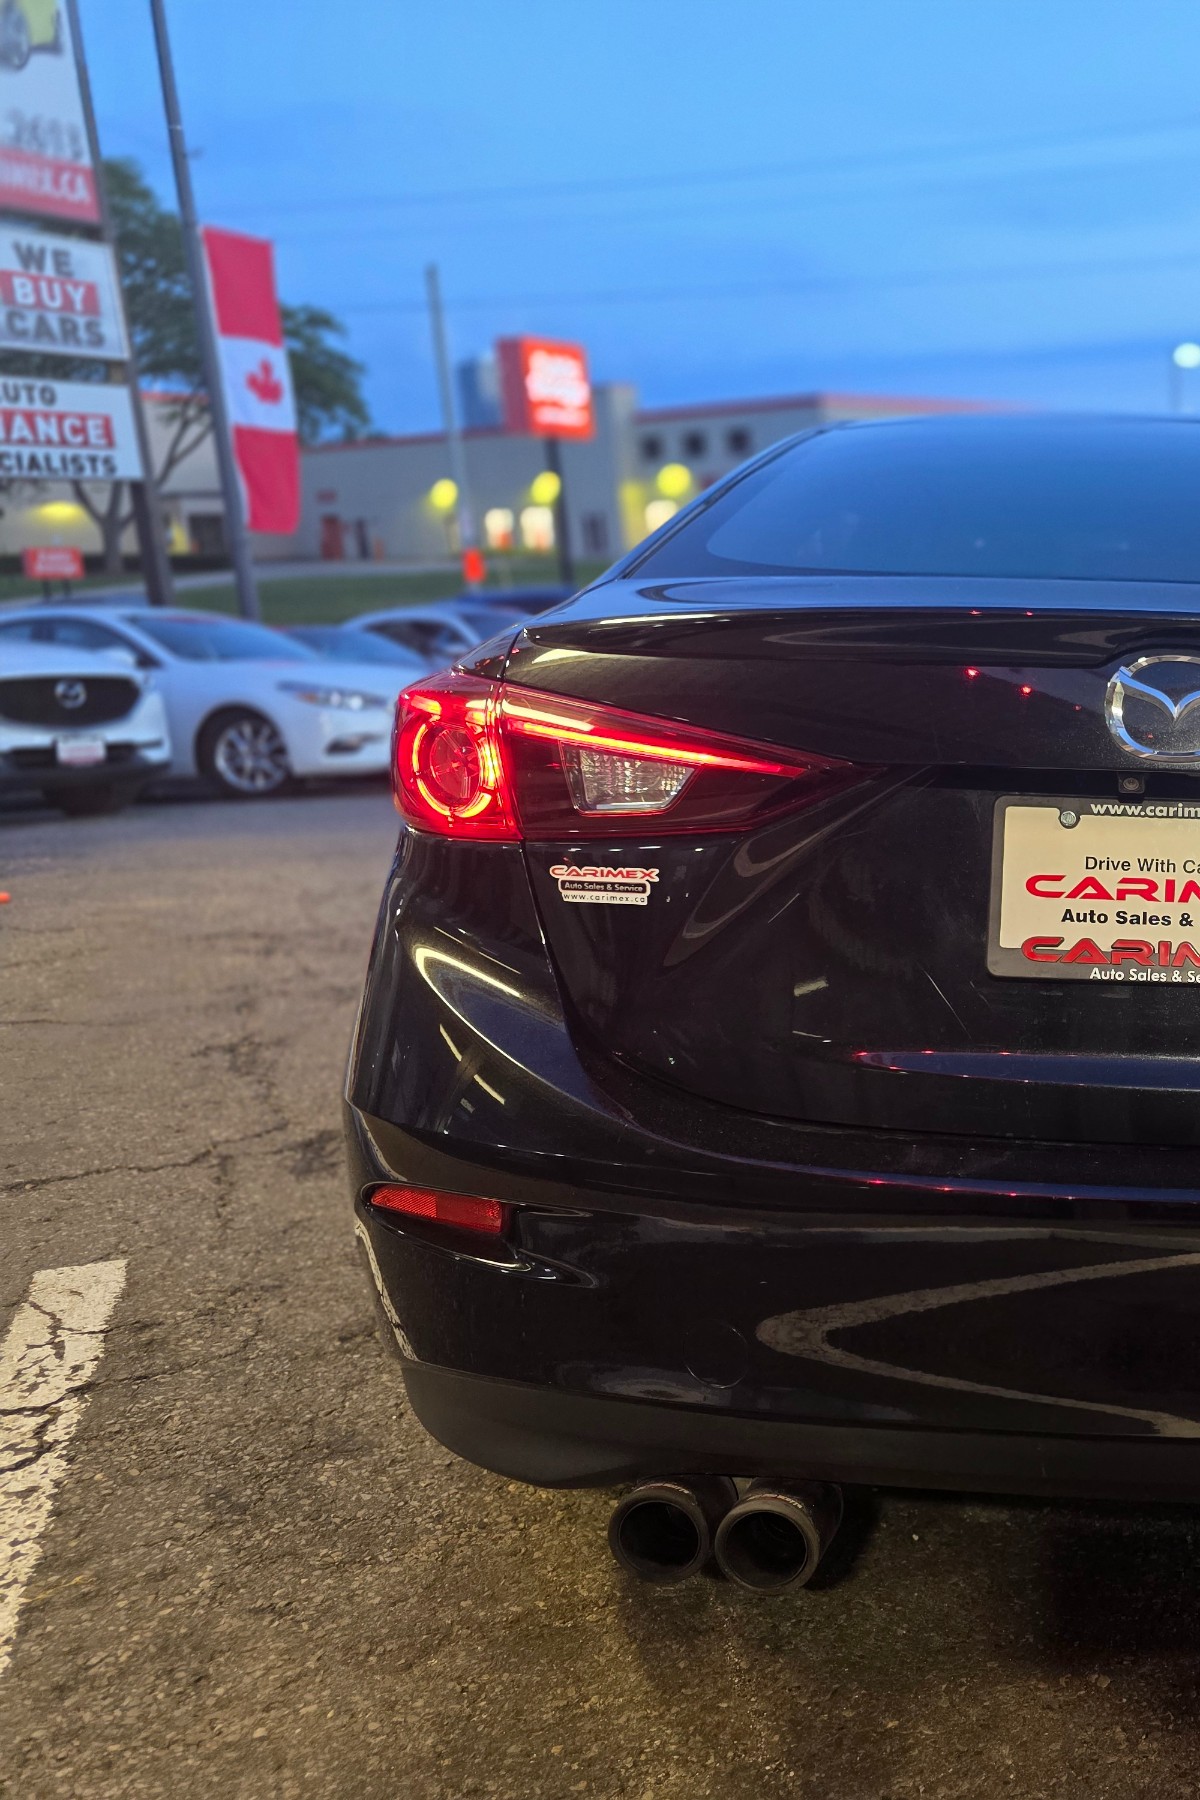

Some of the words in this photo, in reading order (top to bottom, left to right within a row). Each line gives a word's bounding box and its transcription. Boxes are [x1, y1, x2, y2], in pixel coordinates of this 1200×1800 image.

[11, 241, 74, 278] WE
[12, 277, 85, 312] BUY
[6, 310, 106, 348] CARS
[0, 382, 57, 408] UTO
[0, 415, 107, 446] ANCE
[551, 867, 657, 880] CARIMEX
[1085, 856, 1131, 872] Drive
[1137, 857, 1176, 873] With
[564, 882, 582, 890] Auto
[584, 883, 604, 891] Sales
[615, 884, 643, 892] Service
[563, 893, 646, 903] www.carimex.ca
[1061, 908, 1108, 925] Auto
[1115, 910, 1172, 927] Sales
[1179, 912, 1194, 927] &
[1090, 967, 1124, 982] Auto
[1128, 968, 1167, 983] Sales
[1171, 970, 1182, 983] &
